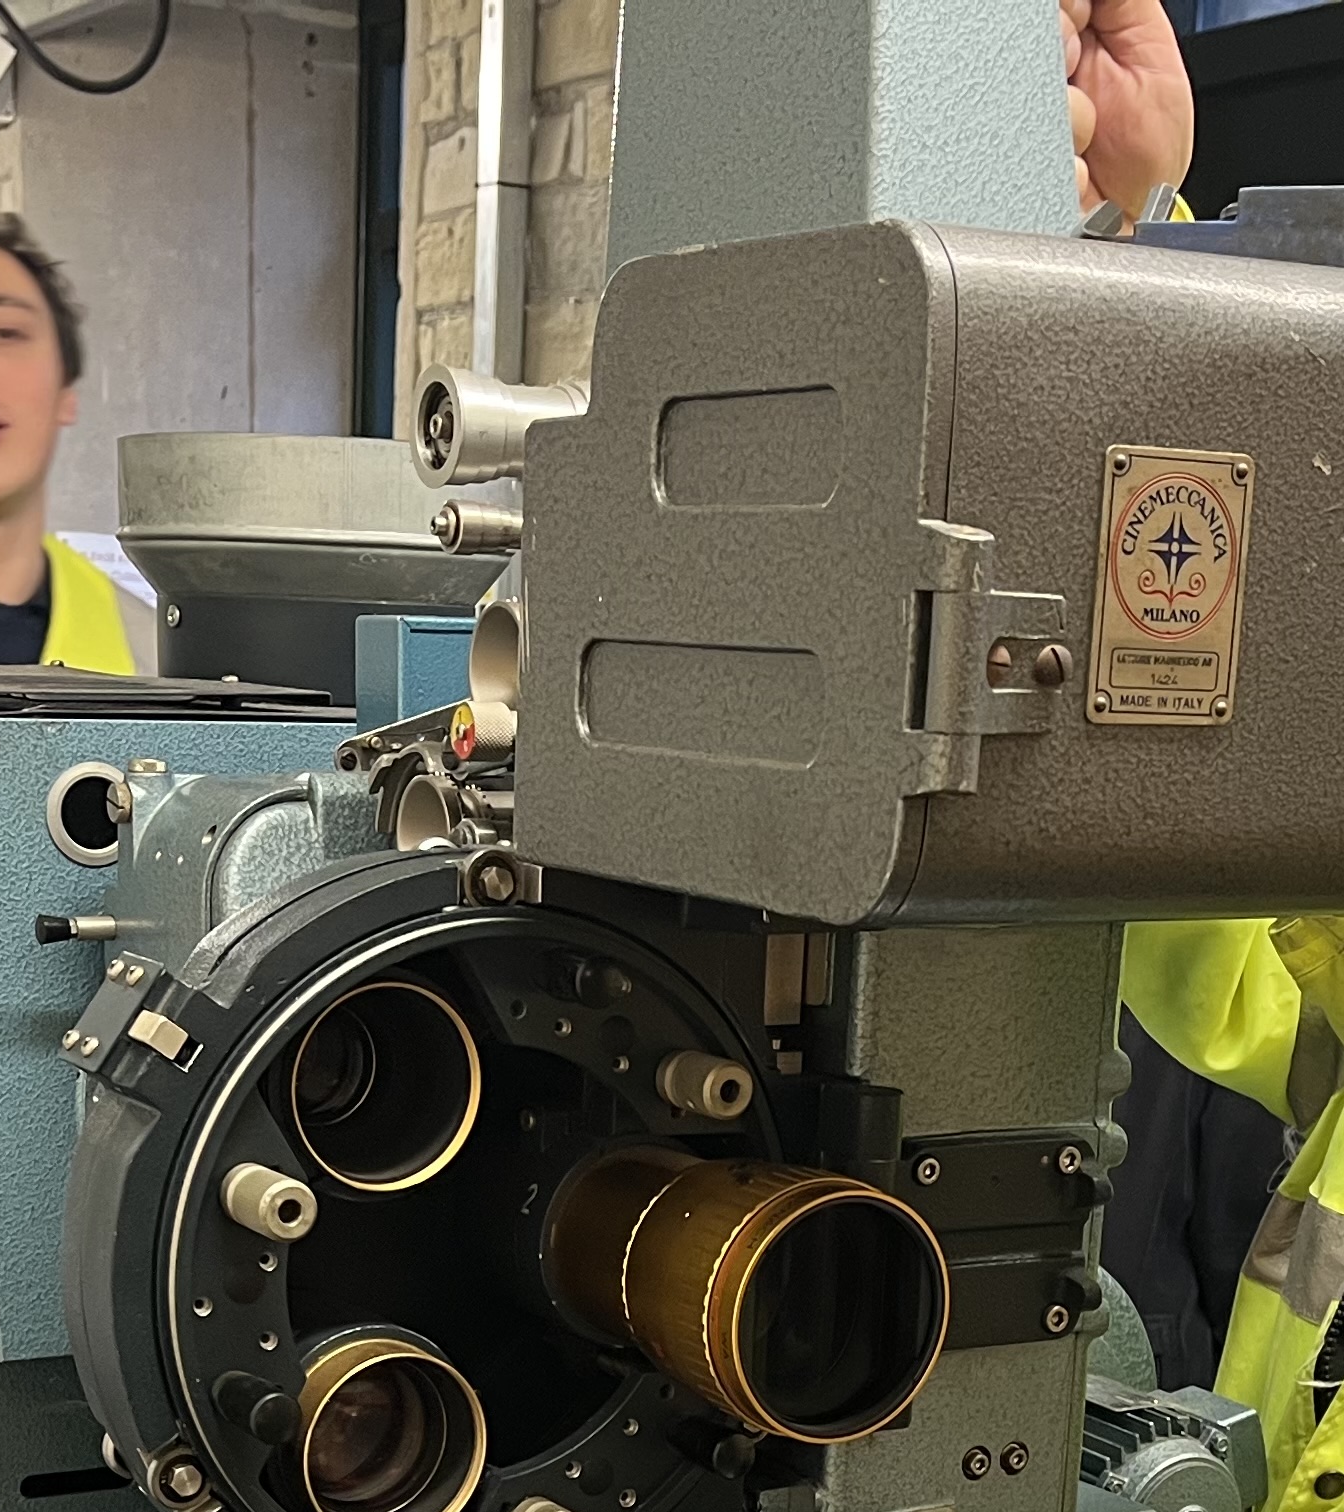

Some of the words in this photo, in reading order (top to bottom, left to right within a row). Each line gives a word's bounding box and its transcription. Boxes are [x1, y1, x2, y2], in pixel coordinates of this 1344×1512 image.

[1120, 485, 1228, 564] CINEMECCANICA
[1140, 607, 1201, 624] MILANO
[1150, 673, 1179, 685] 1424
[1120, 695, 1153, 707] MADE
[1157, 697, 1169, 708] IN
[1173, 697, 1204, 711] ITALY
